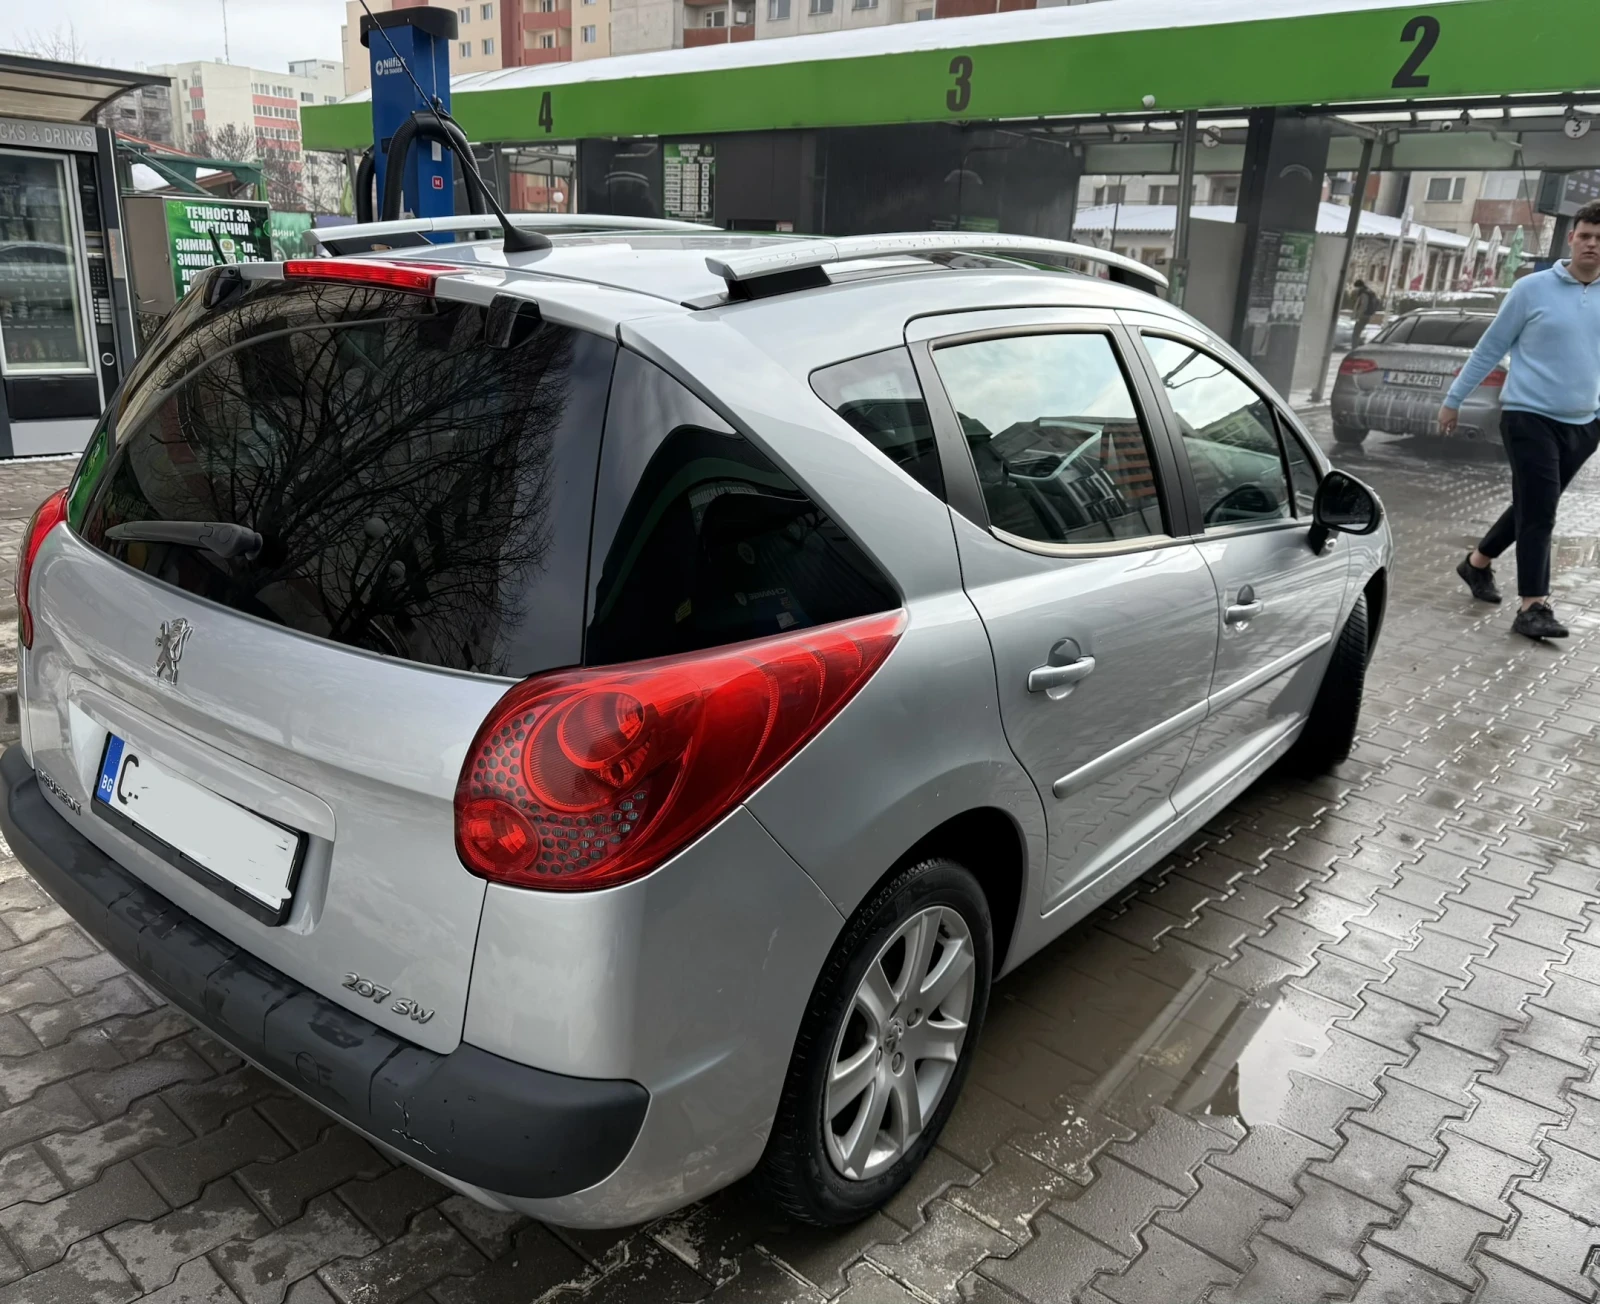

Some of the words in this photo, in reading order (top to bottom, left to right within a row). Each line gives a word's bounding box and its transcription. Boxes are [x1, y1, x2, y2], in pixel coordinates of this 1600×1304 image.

[1391, 15, 1441, 89] 2
[946, 55, 974, 113] 3
[538, 91, 554, 133] 4
[31, 126, 41, 142] &
[44, 127, 93, 147] DRINKS
[185, 206, 234, 221] ТЕЧНОСТ
[237, 209, 251, 222] ЗА
[190, 220, 249, 236] ЧИСТАЧКИ
[175, 238, 213, 252] ЗИМНА
[177, 253, 215, 267] ЗИМНА
[101, 774, 114, 793] BG
[342, 971, 391, 1004] 207
[391, 998, 435, 1024] SW
